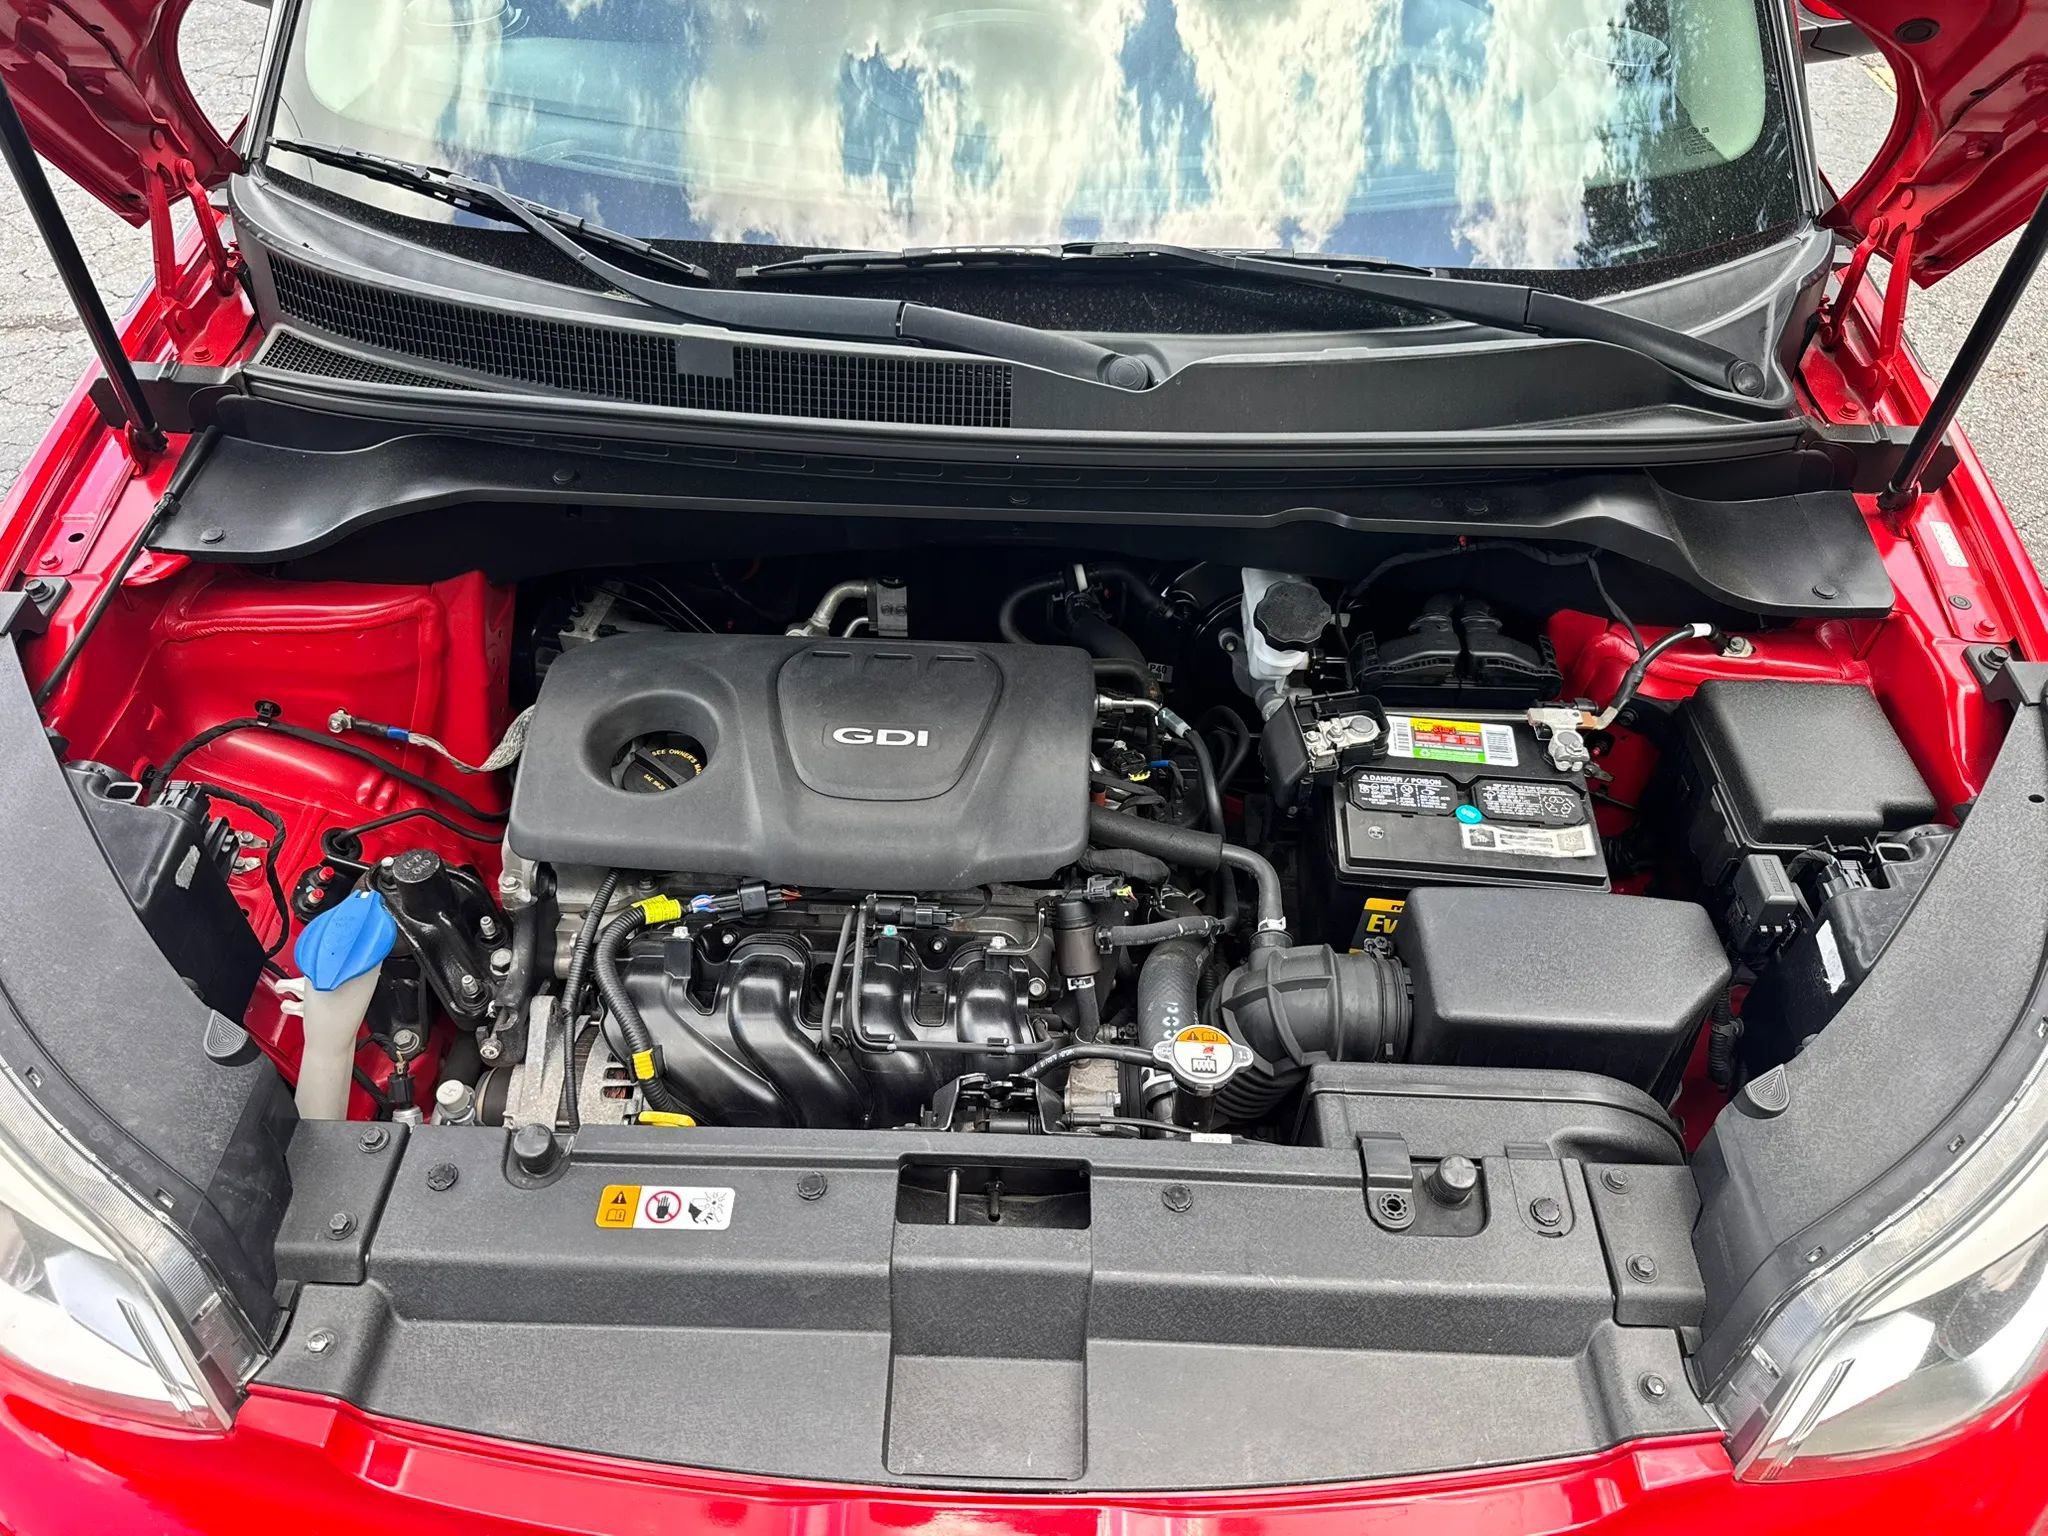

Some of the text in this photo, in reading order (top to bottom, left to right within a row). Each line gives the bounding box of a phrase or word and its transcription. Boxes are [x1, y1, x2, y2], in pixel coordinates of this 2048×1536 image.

[832, 727, 929, 747] GDI
[1369, 774, 1403, 783] DANGER
[1410, 777, 1442, 786] POISON
[1366, 913, 1399, 934] Ev
